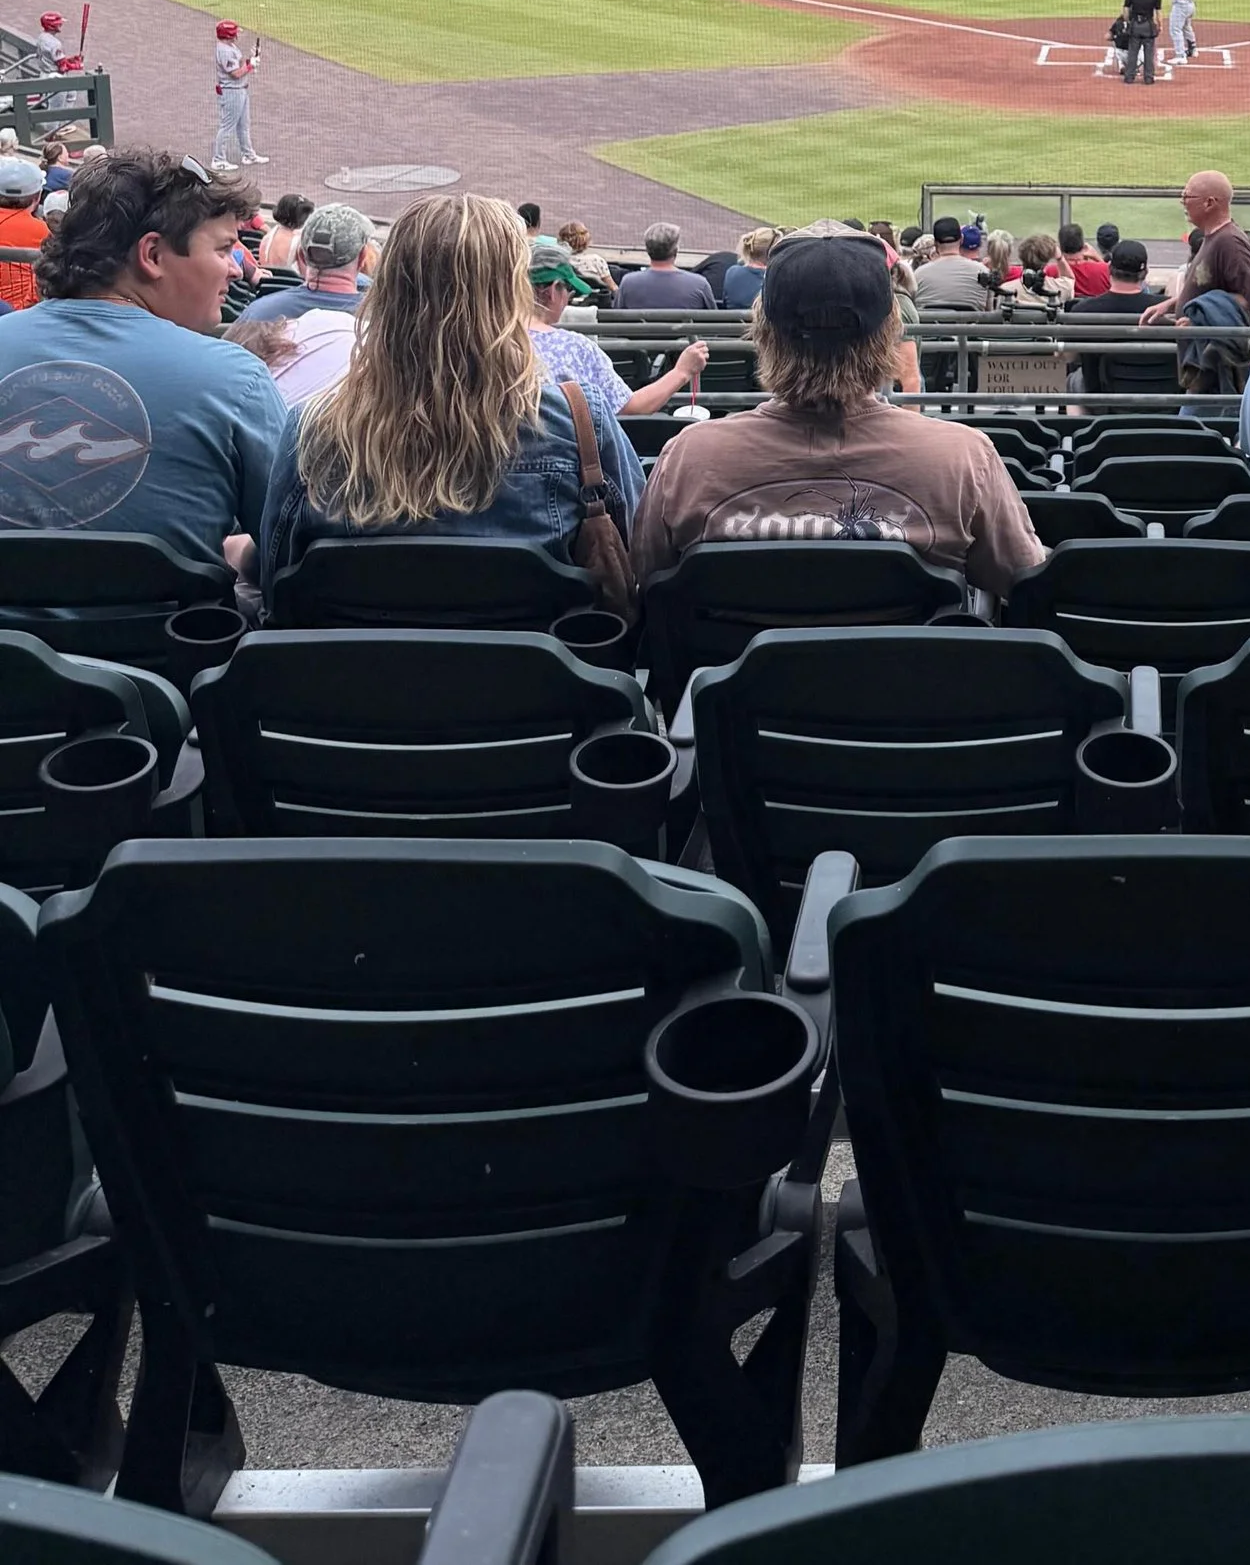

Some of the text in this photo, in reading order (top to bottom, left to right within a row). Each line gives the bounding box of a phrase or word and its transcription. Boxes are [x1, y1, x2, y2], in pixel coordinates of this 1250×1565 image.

[987, 361, 1058, 370] WATCH OUT
[987, 373, 1009, 383] FOR
[987, 385, 1015, 393] FOUL
